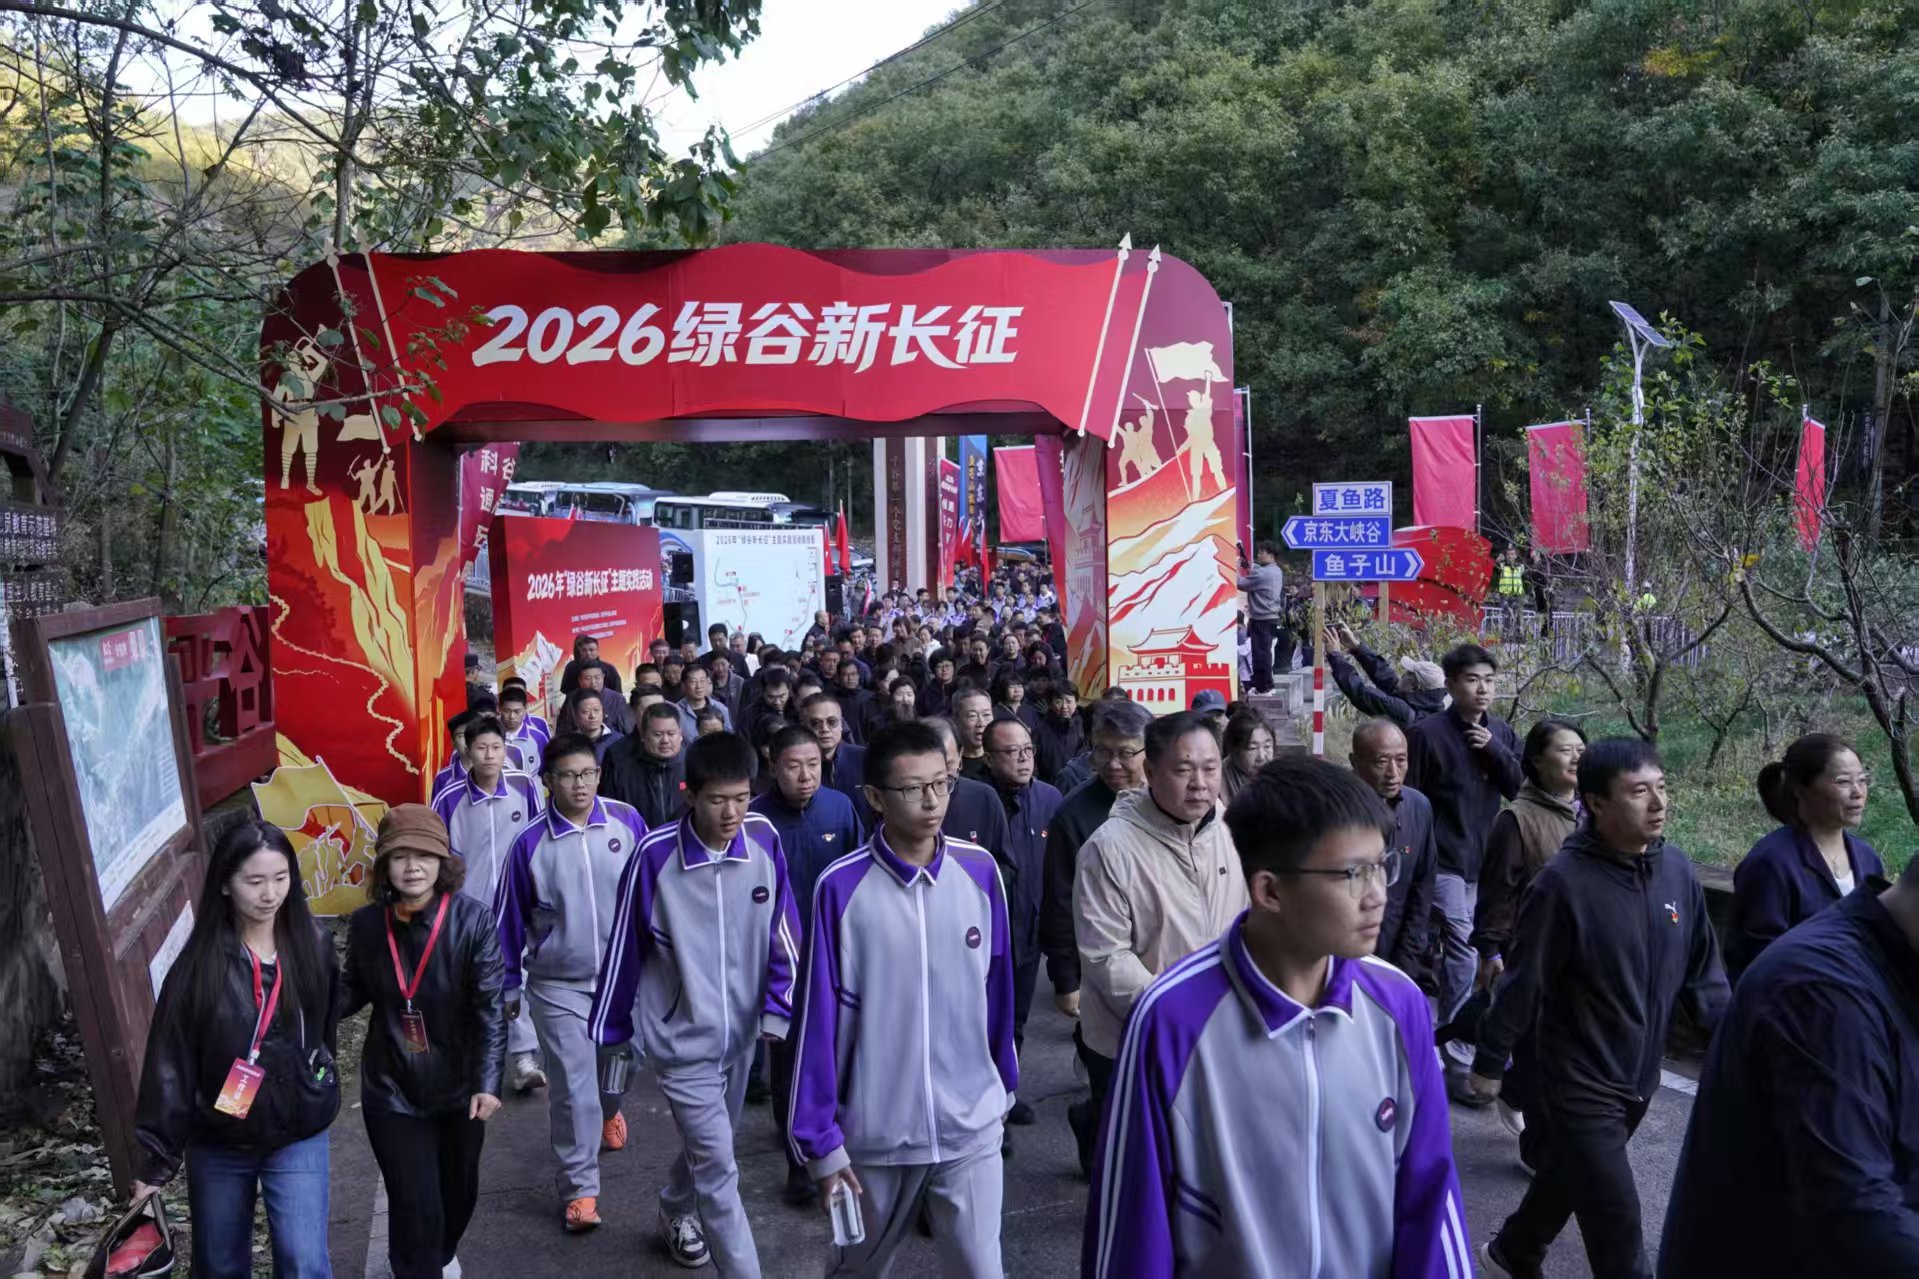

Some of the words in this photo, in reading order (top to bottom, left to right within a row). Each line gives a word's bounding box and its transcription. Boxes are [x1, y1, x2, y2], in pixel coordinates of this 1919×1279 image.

[472, 301, 1025, 373] 2026绿谷新长征
[1318, 487, 1386, 511] 夏鱼路
[1303, 520, 1382, 544] 京东大峡谷
[1324, 553, 1396, 577] 鱼子山
